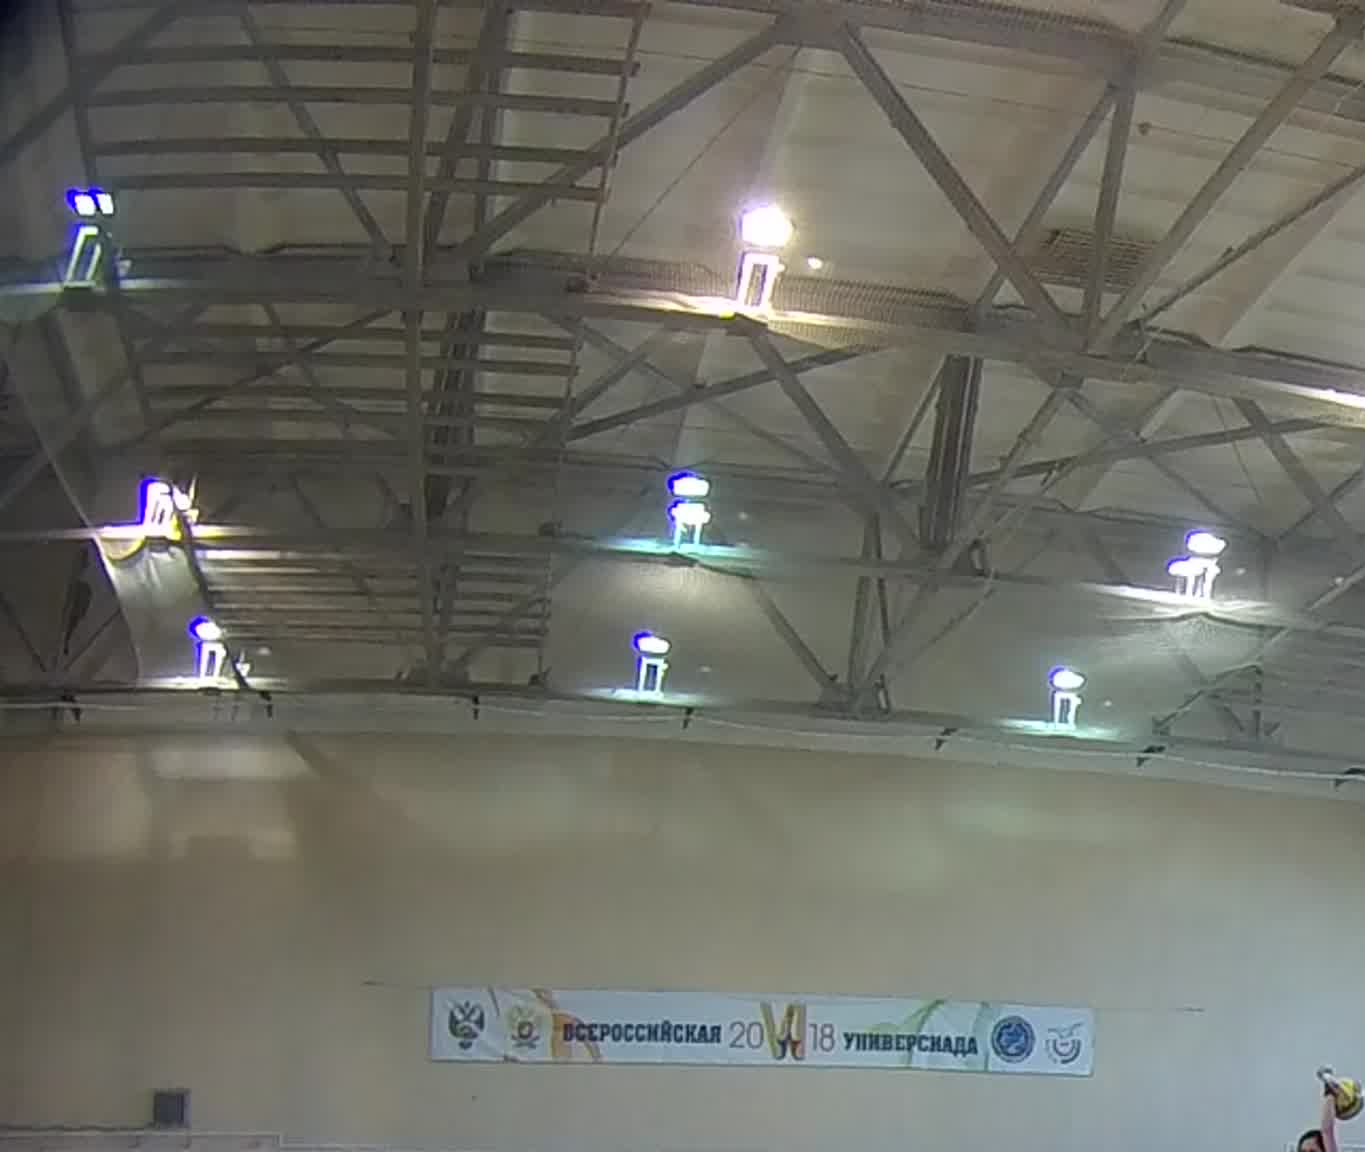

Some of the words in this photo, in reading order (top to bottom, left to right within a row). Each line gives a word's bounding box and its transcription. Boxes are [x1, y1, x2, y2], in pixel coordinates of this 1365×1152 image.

[563, 1019, 722, 1044] ВСЕРОССИЙСКАЯ
[729, 1021, 764, 1049] 20
[843, 1031, 978, 1058] УНИВЕРСИАДА
